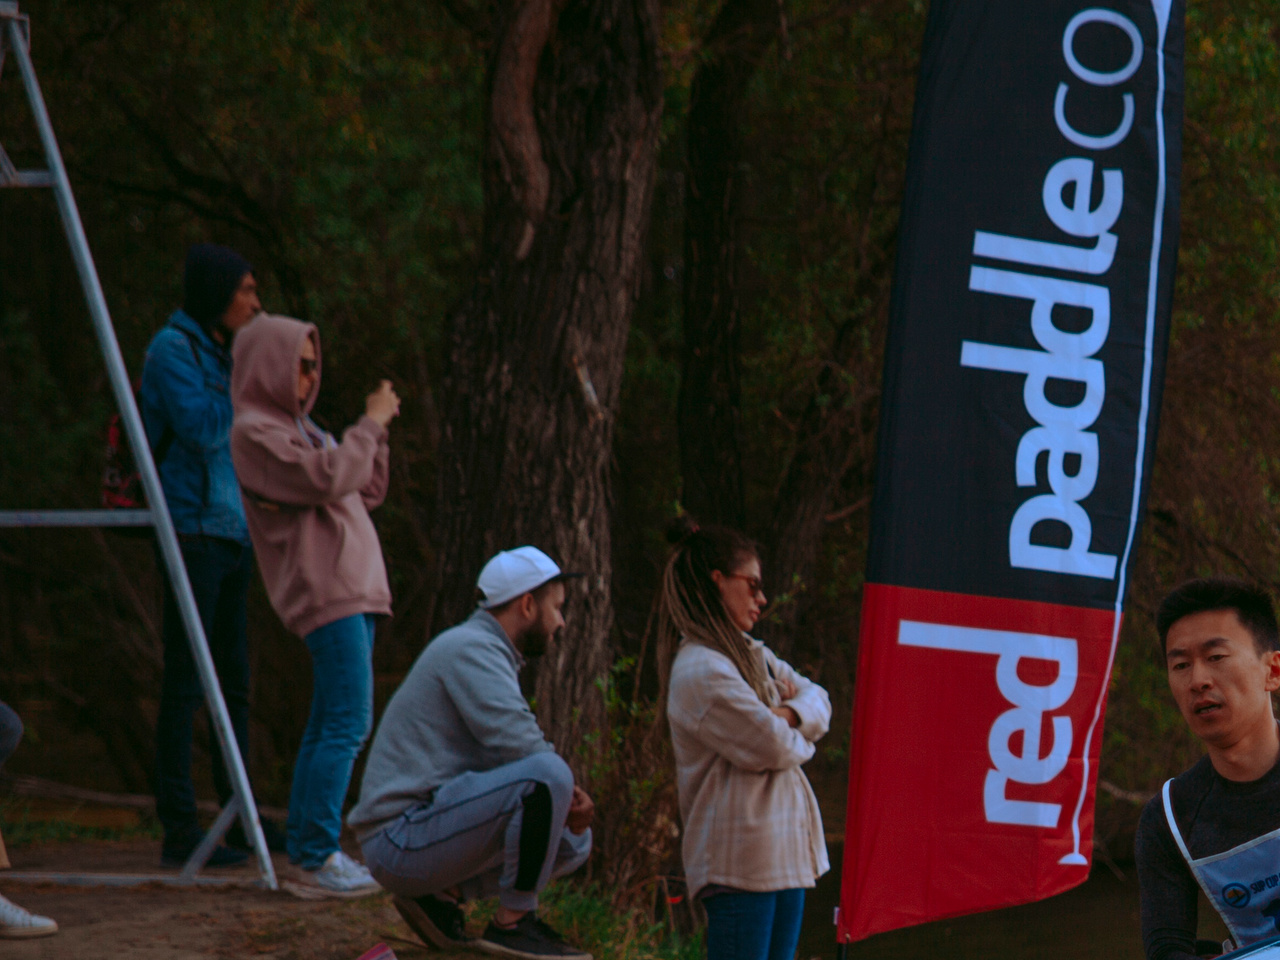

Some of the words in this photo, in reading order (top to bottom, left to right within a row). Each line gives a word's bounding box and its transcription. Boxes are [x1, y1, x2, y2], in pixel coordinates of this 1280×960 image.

[897, 618, 1079, 829] red
[1250, 882, 1266, 894] SUP
[1265, 874, 1279, 888] CUP
